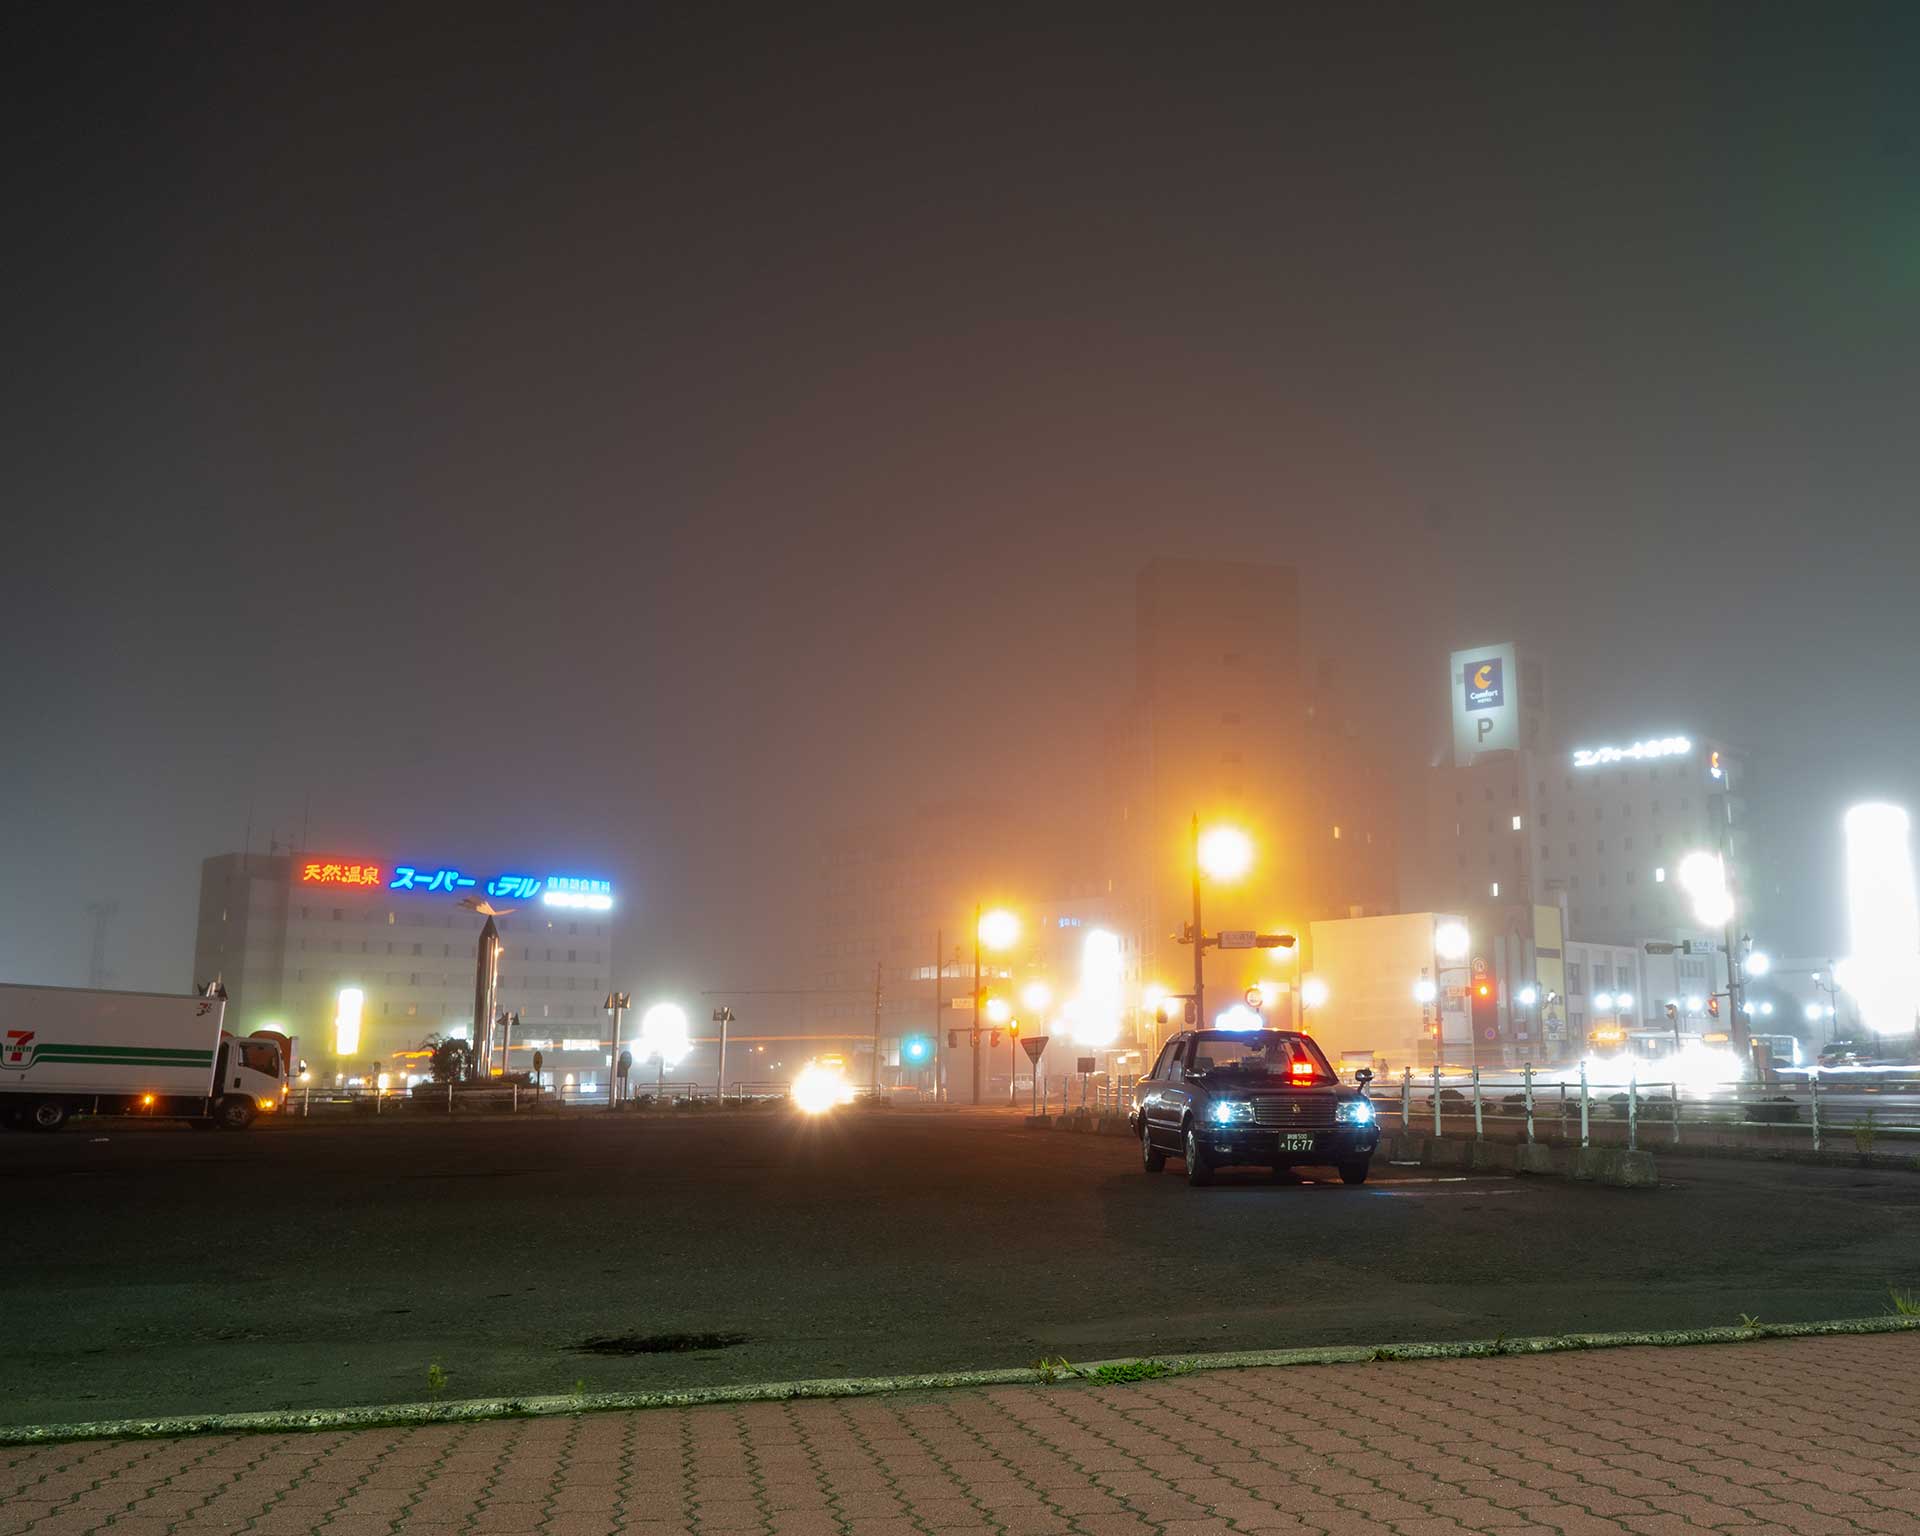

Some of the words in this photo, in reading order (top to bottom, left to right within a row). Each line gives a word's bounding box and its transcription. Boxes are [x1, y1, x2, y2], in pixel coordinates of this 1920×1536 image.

[1469, 689, 1499, 700] Comfort
[1477, 717, 1494, 743] P
[303, 864, 380, 885] 天然温泉
[1287, 1139, 1313, 1151] 16-77
